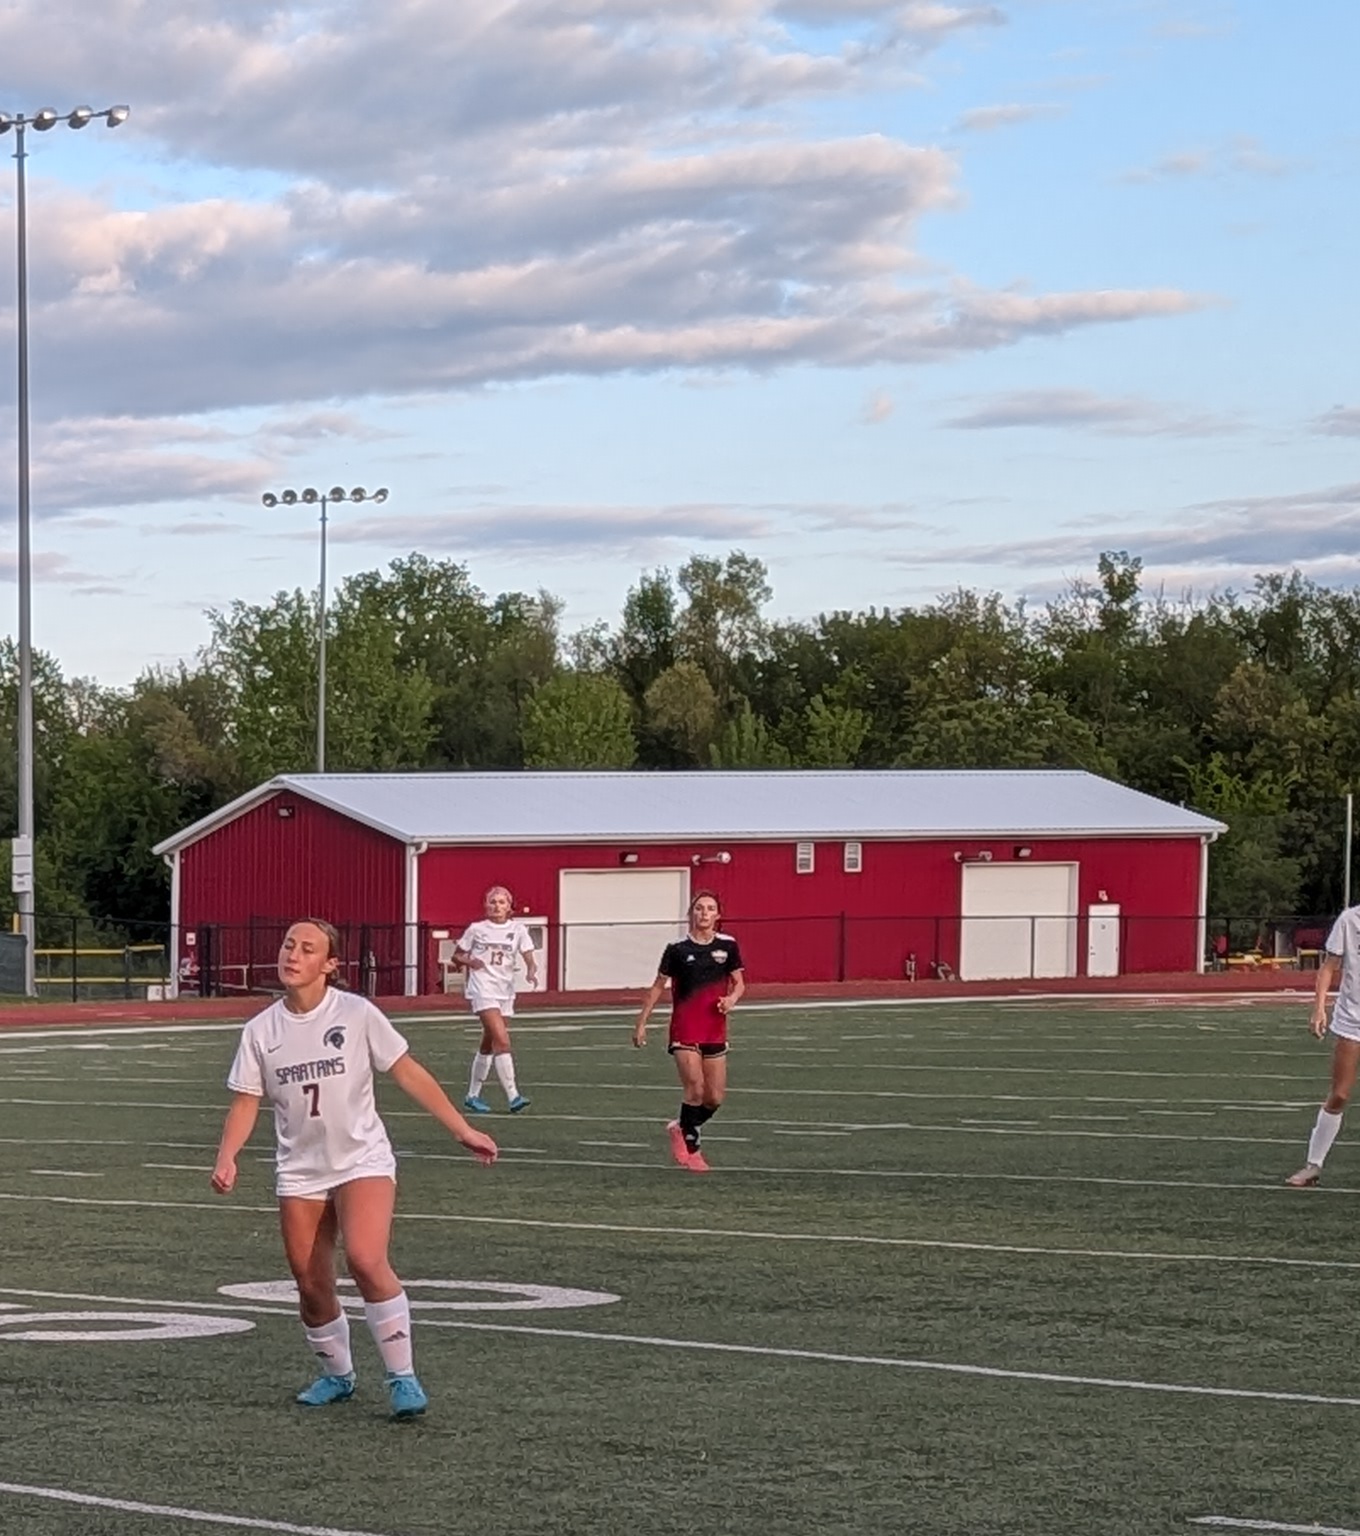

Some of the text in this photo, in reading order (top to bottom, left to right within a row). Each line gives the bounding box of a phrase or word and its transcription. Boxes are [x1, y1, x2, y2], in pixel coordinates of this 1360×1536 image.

[490, 951, 504, 966] 13
[276, 1057, 346, 1085] SPARTANS
[302, 1083, 321, 1117] 7
